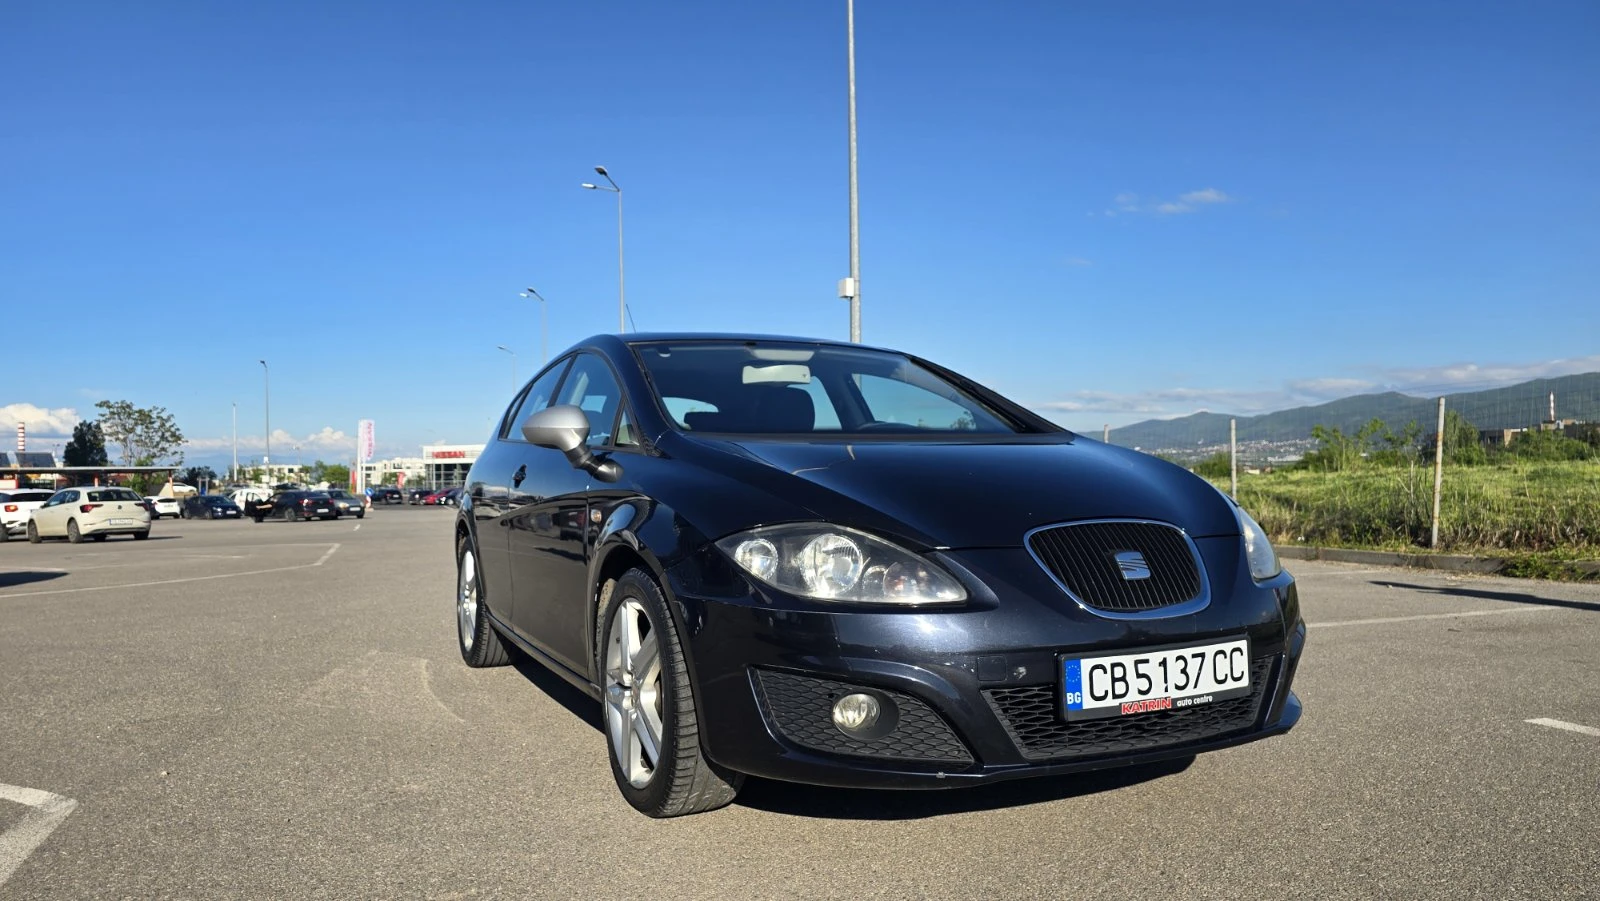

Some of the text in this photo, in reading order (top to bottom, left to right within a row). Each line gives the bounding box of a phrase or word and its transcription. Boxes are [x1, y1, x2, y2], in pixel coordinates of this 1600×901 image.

[431, 451, 465, 459] NISSAN
[1066, 692, 1082, 704] BG
[1121, 697, 1172, 715] KATRIN
[1176, 697, 1193, 707] auto
